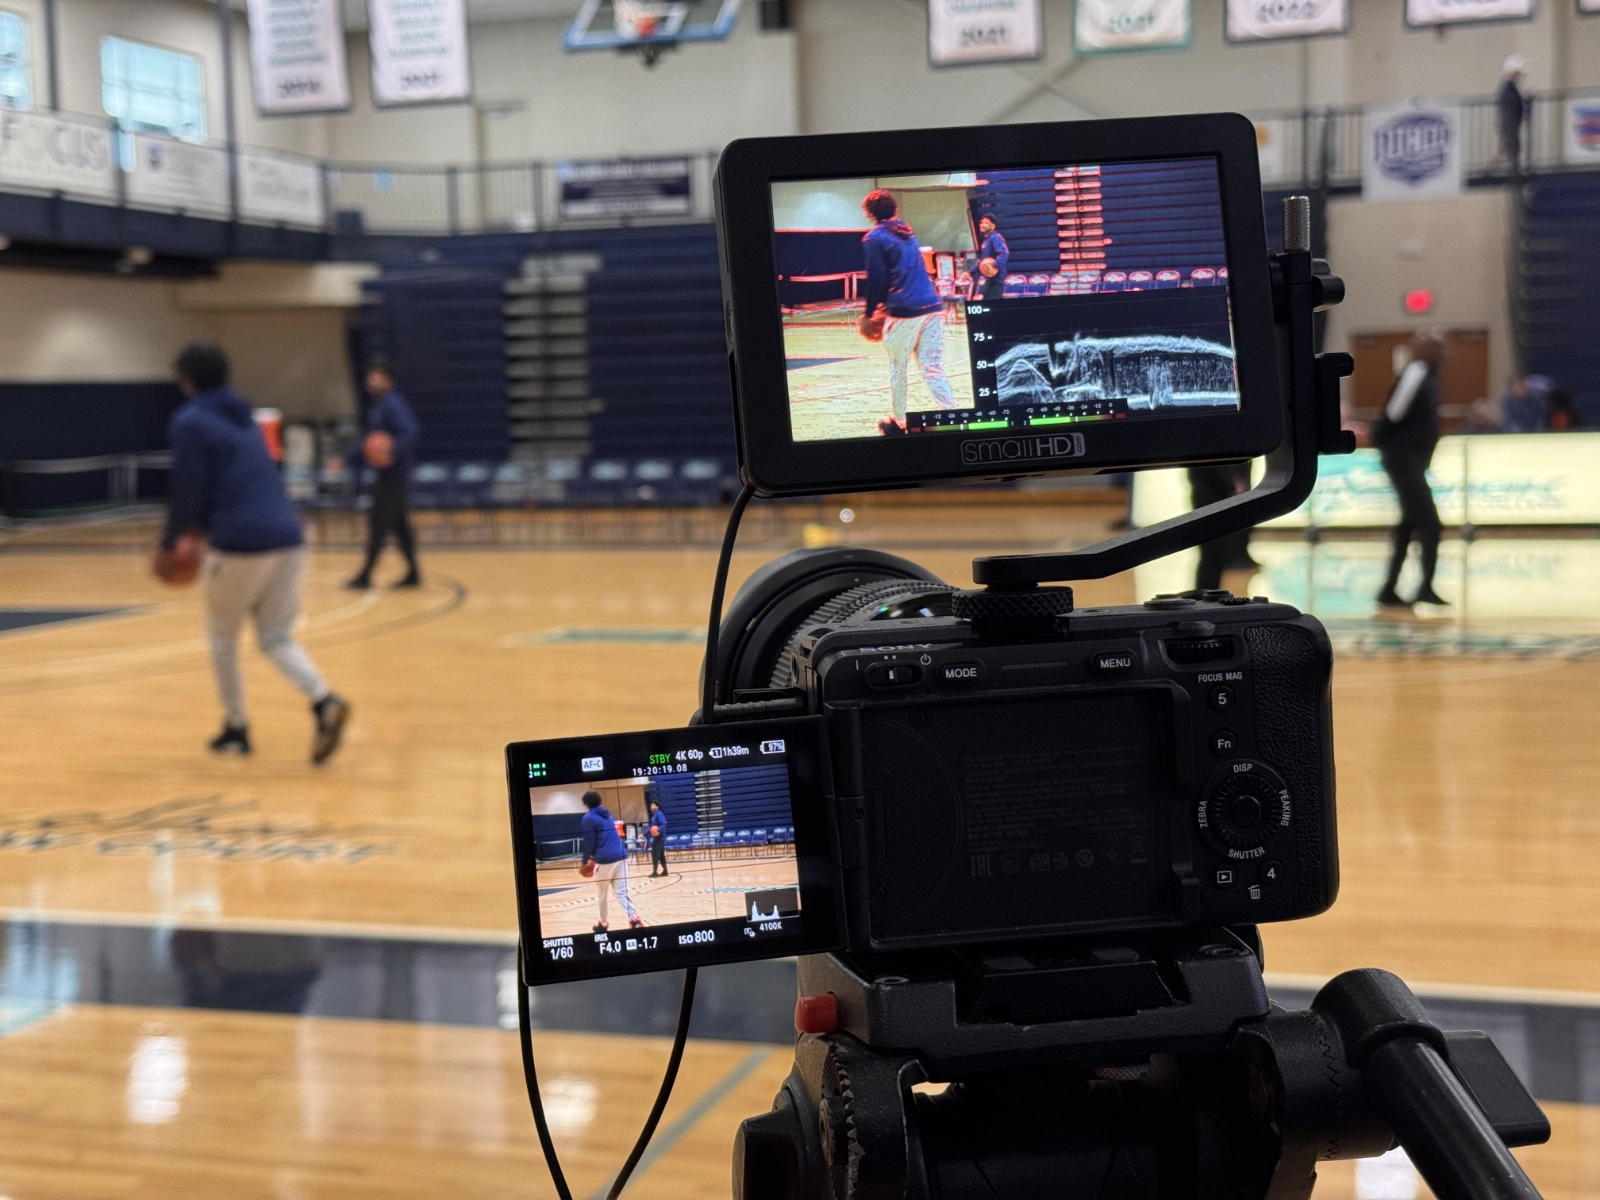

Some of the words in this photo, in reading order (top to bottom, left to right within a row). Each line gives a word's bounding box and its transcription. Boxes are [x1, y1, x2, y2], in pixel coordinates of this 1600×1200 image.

[967, 305, 983, 315] 100
[973, 332, 985, 342] 75
[976, 360, 987, 369] 50
[978, 387, 990, 397] 25
[964, 435, 1071, 462] smallHD
[1100, 658, 1131, 669] MENU
[945, 667, 977, 679] MODE
[1198, 673, 1223, 683] FOCUS
[1226, 672, 1243, 681] MAG
[1218, 692, 1227, 705] 5
[768, 742, 783, 751] 97%
[1217, 738, 1231, 749] Fn
[649, 753, 671, 765] STBY
[675, 750, 687, 761] 4K
[688, 749, 703, 761] 60p
[723, 746, 749, 757] 1h39m
[583, 759, 602, 769] AF-C
[1233, 763, 1252, 773] DISP
[528, 770, 533, 778] 2
[632, 764, 687, 776] 19:20:19.08
[1278, 789, 1291, 827] PEAKING
[1198, 800, 1208, 829] ZEBRA
[1228, 846, 1265, 860] SHUTTER
[1267, 867, 1276, 879] 4
[759, 921, 782, 931] 4100K
[594, 933, 608, 942] IRIS
[678, 934, 693, 944] ISO
[694, 929, 715, 943] 800
[542, 937, 574, 948] SHUTTER
[599, 940, 622, 954] F4.0
[638, 936, 658, 949] -1.7
[550, 946, 574, 960] 1/60
